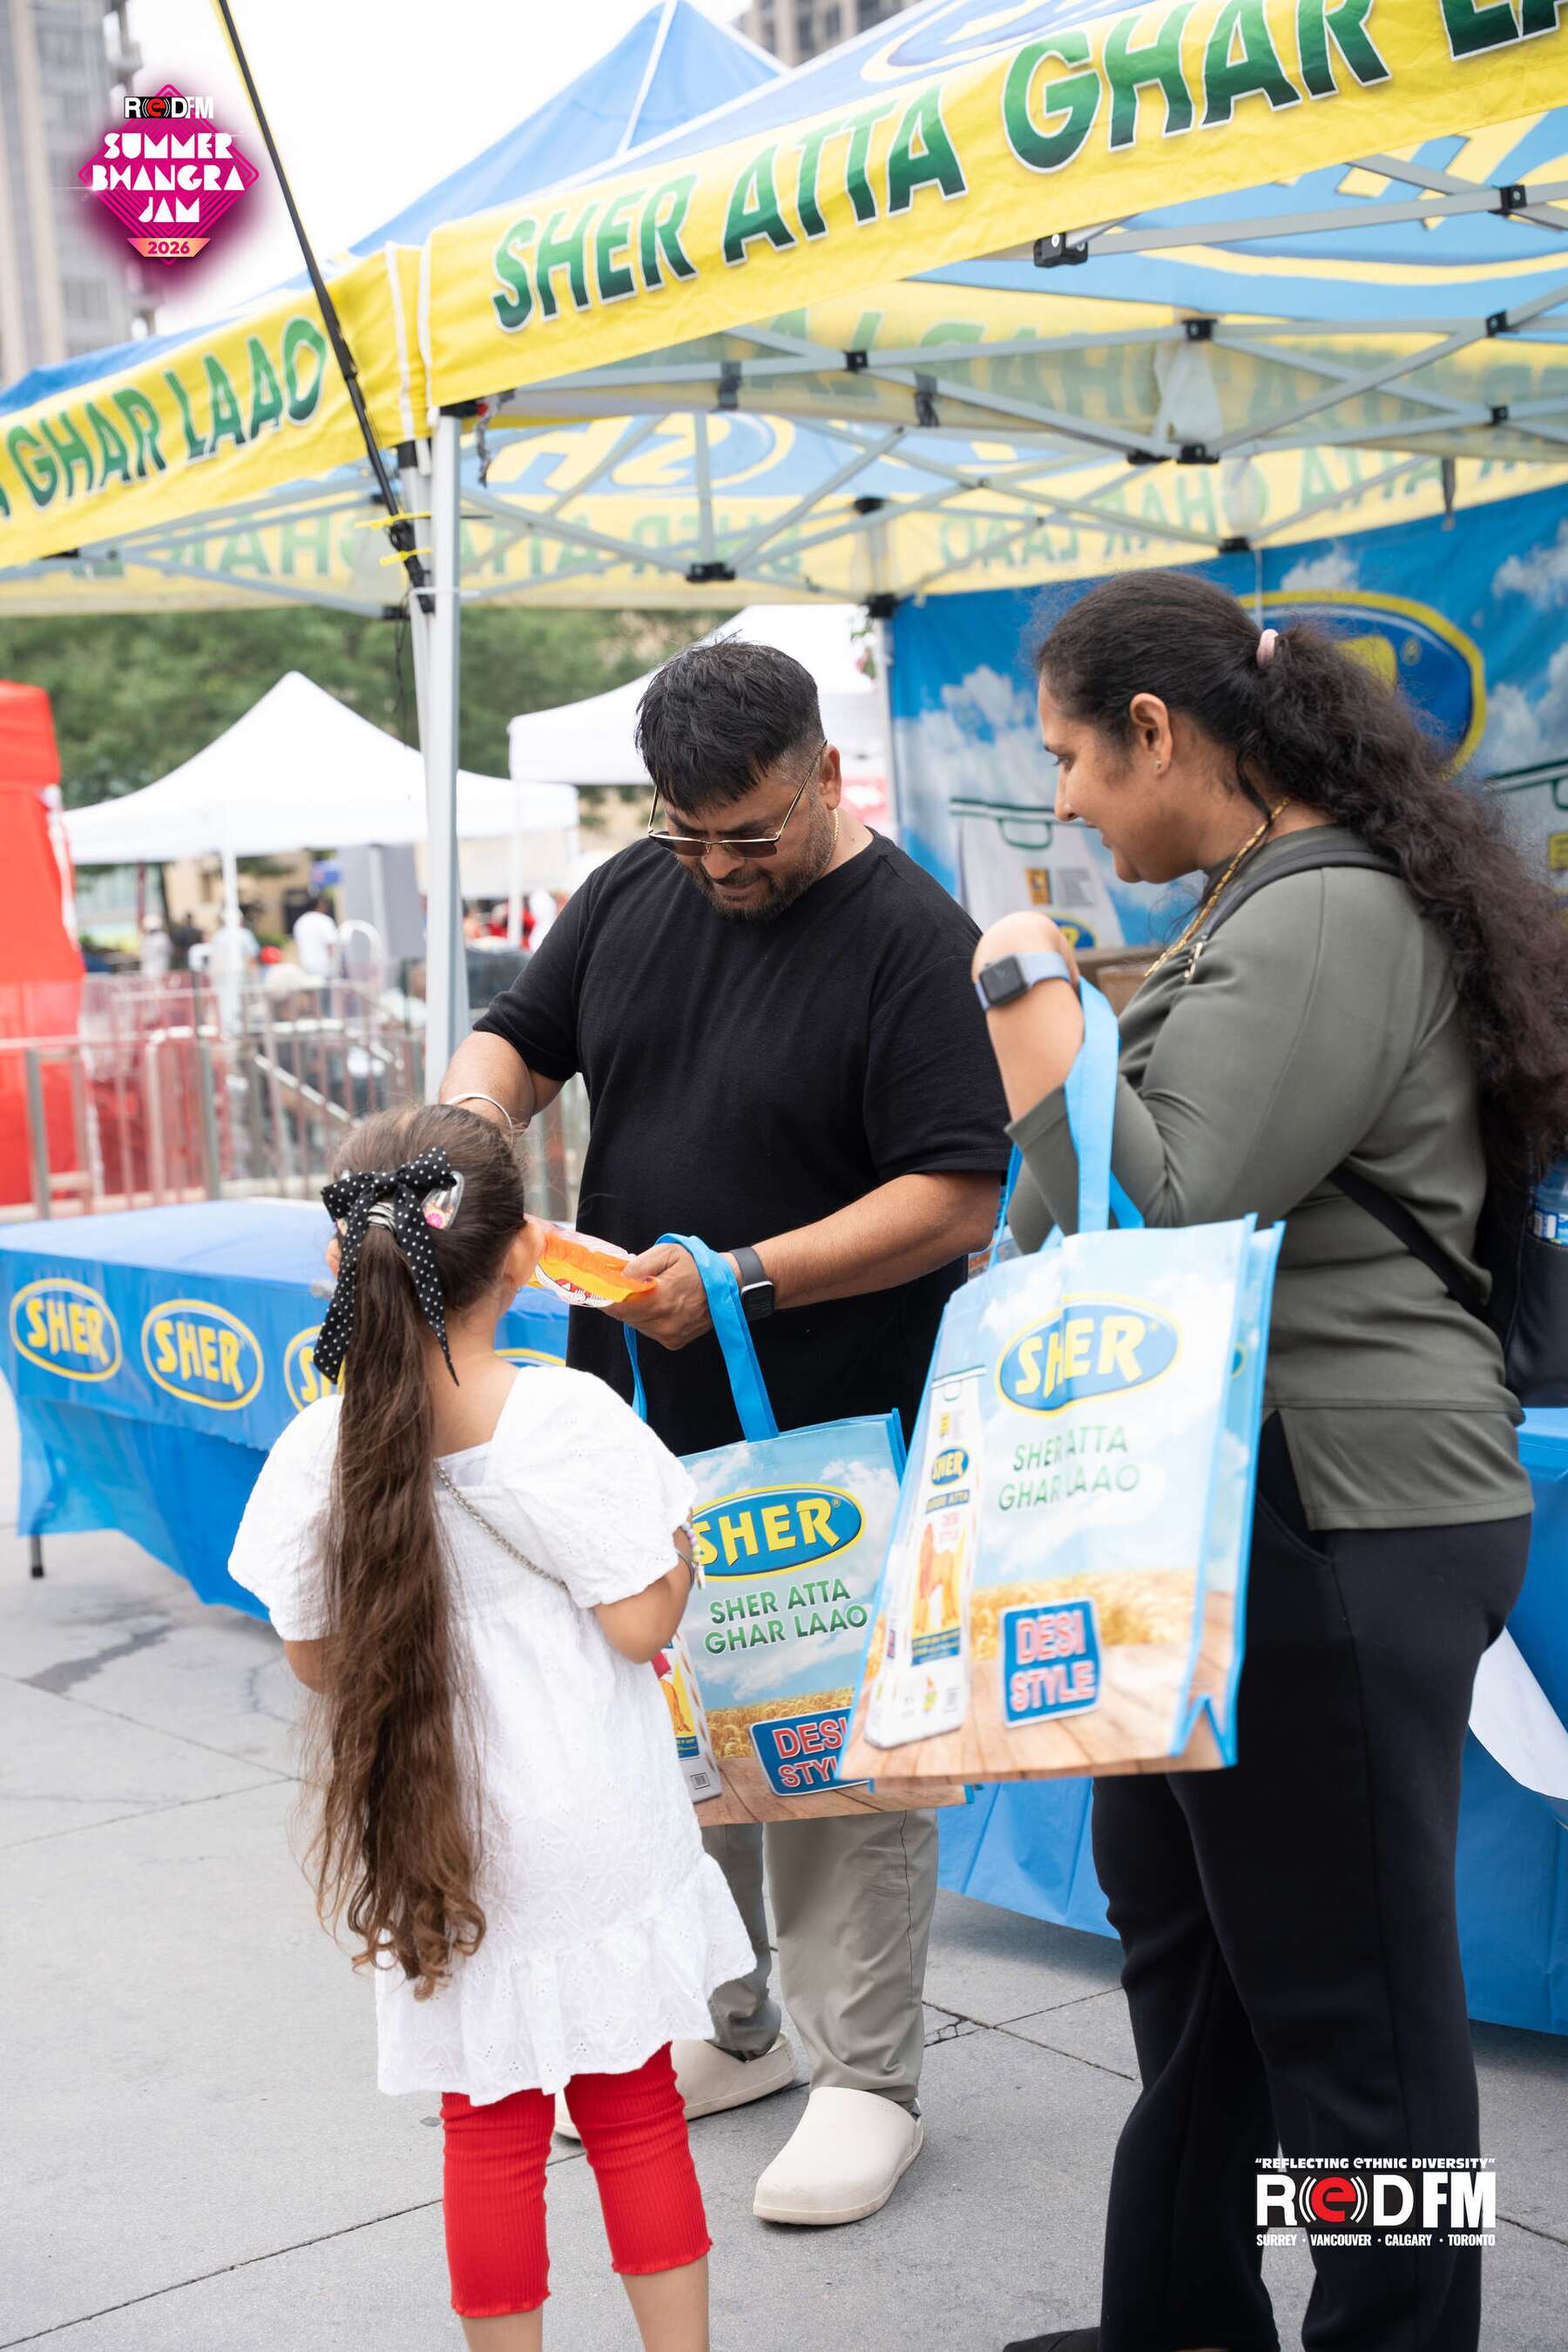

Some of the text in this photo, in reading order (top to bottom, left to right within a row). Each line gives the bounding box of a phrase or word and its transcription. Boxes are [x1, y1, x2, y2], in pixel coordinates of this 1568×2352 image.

[490, 172, 698, 333] SHER
[721, 83, 969, 266] ATTA
[1001, 0, 1391, 174] GHAR
[4, 316, 328, 509] GHAR LAAO
[25, 1298, 110, 1366] SHER
[153, 1320, 245, 1394] SHER
[1015, 1315, 1146, 1398] SHER
[1064, 1425, 1129, 1456] ATTA
[692, 1497, 841, 1566] SHER
[704, 1605, 868, 1654] GHAR LAAO
[710, 1578, 851, 1625] SHER ATTA
[1016, 1610, 1087, 1666] DESI
[1010, 1659, 1095, 1713] STYLE
